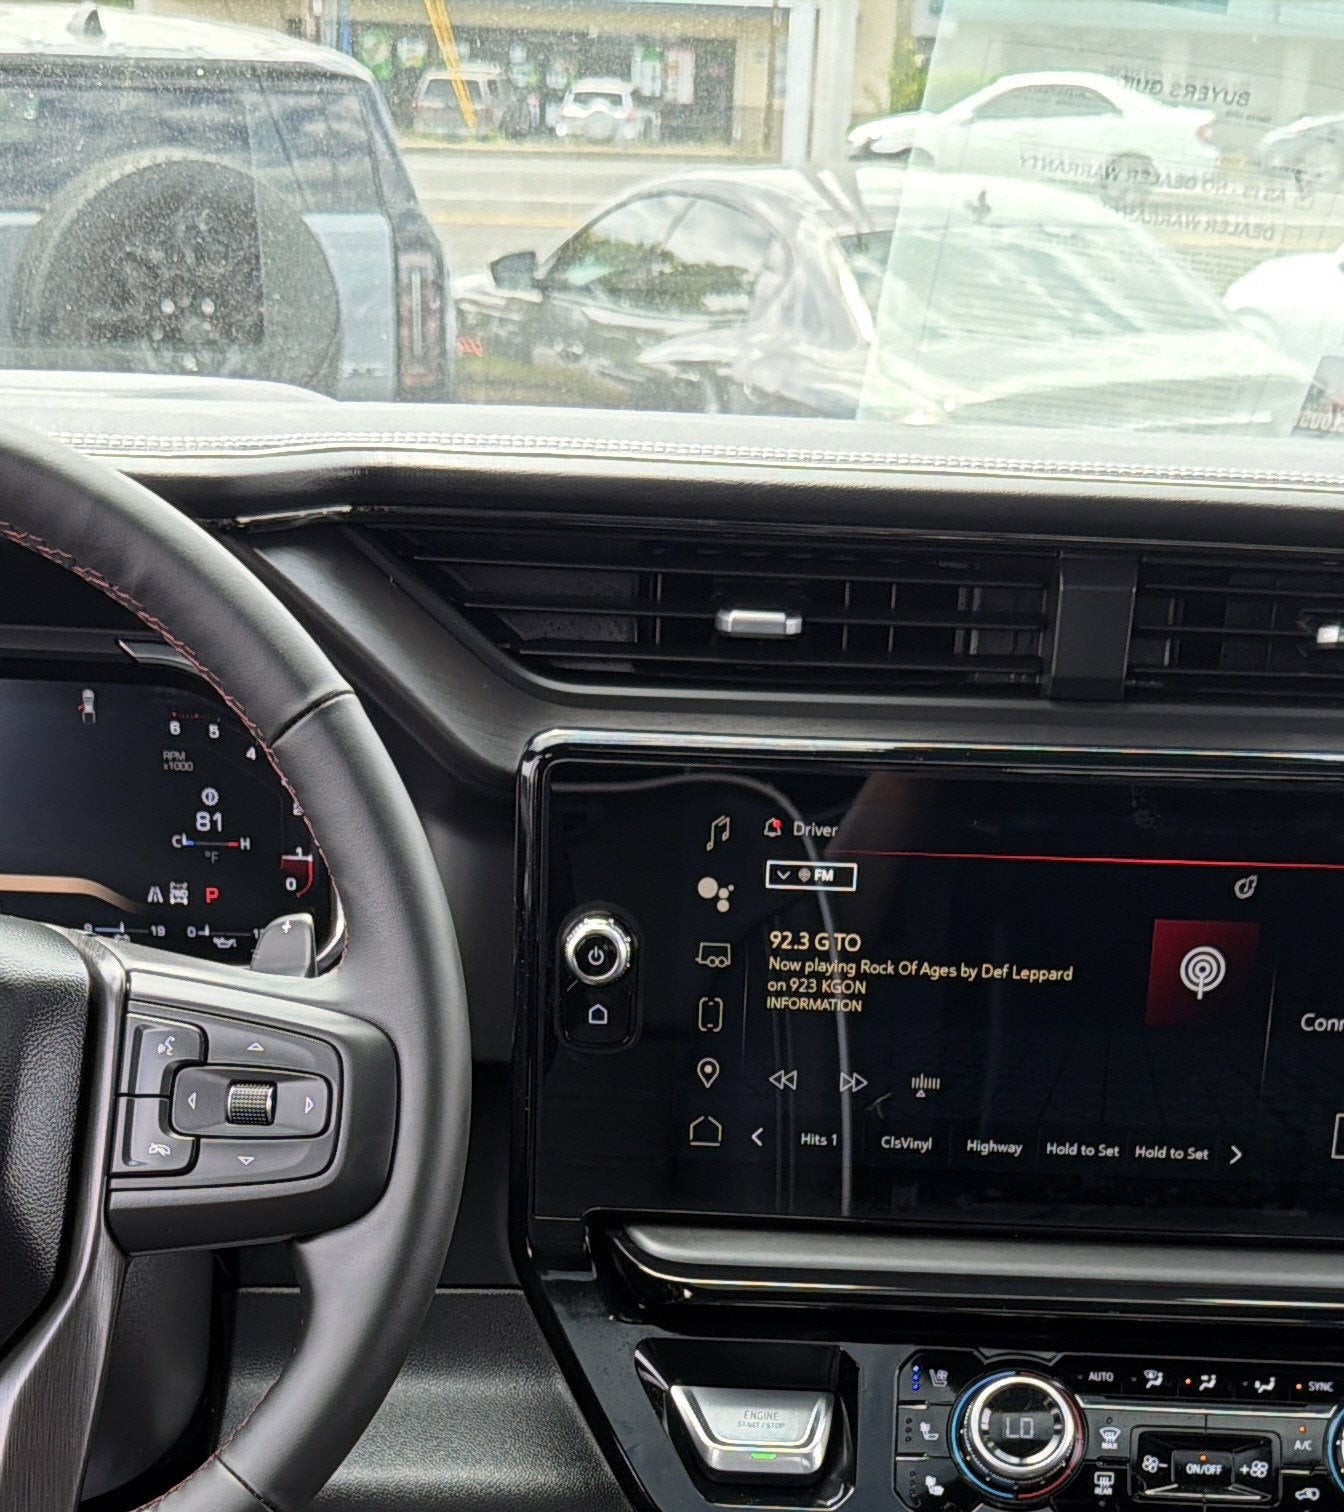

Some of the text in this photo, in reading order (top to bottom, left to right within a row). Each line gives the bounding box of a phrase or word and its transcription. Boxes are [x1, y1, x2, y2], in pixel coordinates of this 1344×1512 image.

[196, 811, 223, 832] 81
[792, 819, 839, 839] Driver
[814, 867, 835, 883] FM
[206, 887, 221, 904] P
[769, 930, 862, 952] 92.3 G TO
[768, 956, 1074, 985] Now playing Rock Of Ages by Def Leppard
[767, 978, 867, 995] on 923 KGON
[766, 996, 863, 1013] INFORMATION
[800, 1132, 839, 1147] Hits 1
[966, 1139, 1025, 1158] Highway
[1045, 1141, 1121, 1158] Hold to Set
[1134, 1144, 1210, 1162] Hold to Set
[1088, 1371, 1115, 1383] AUTO
[1308, 1381, 1334, 1393] SYNC
[743, 1409, 780, 1422] ENGINE
[1004, 1416, 1035, 1441] LO
[1293, 1439, 1314, 1452] A/C
[1185, 1463, 1223, 1476] ON/OFF
